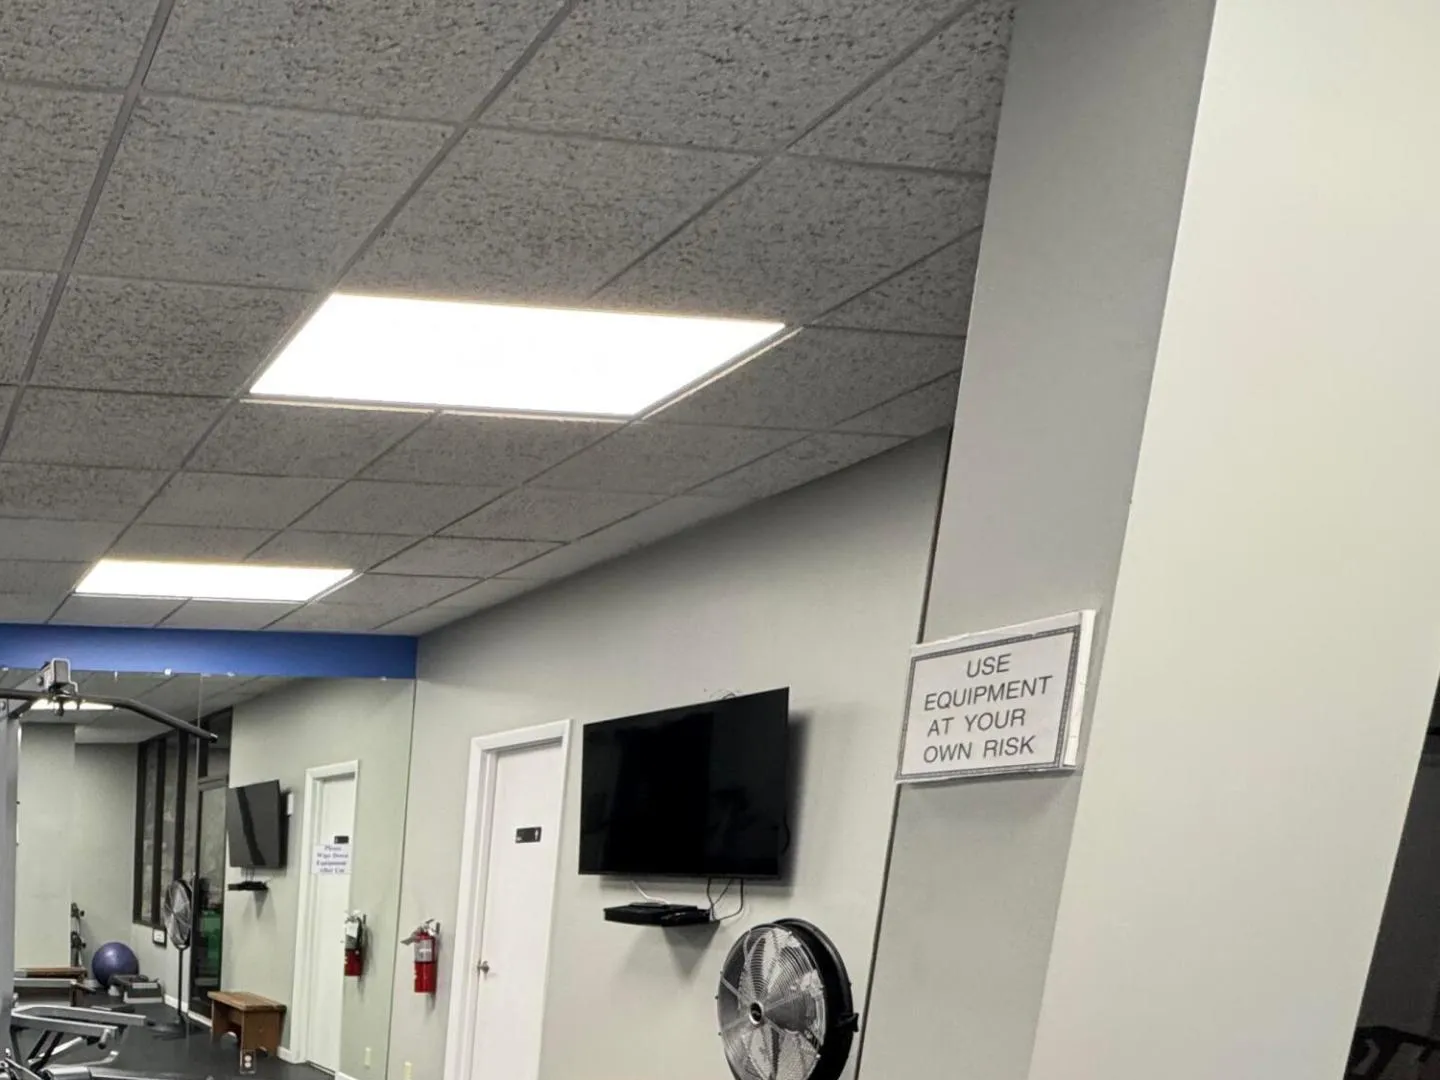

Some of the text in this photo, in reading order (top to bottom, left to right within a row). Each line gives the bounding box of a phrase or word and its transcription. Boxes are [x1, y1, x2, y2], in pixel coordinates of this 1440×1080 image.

[966, 654, 1012, 678] USE
[924, 675, 1053, 712] EQUIPMENT
[927, 708, 1026, 737] AT YOUR
[923, 735, 1036, 763] OWN RISK
